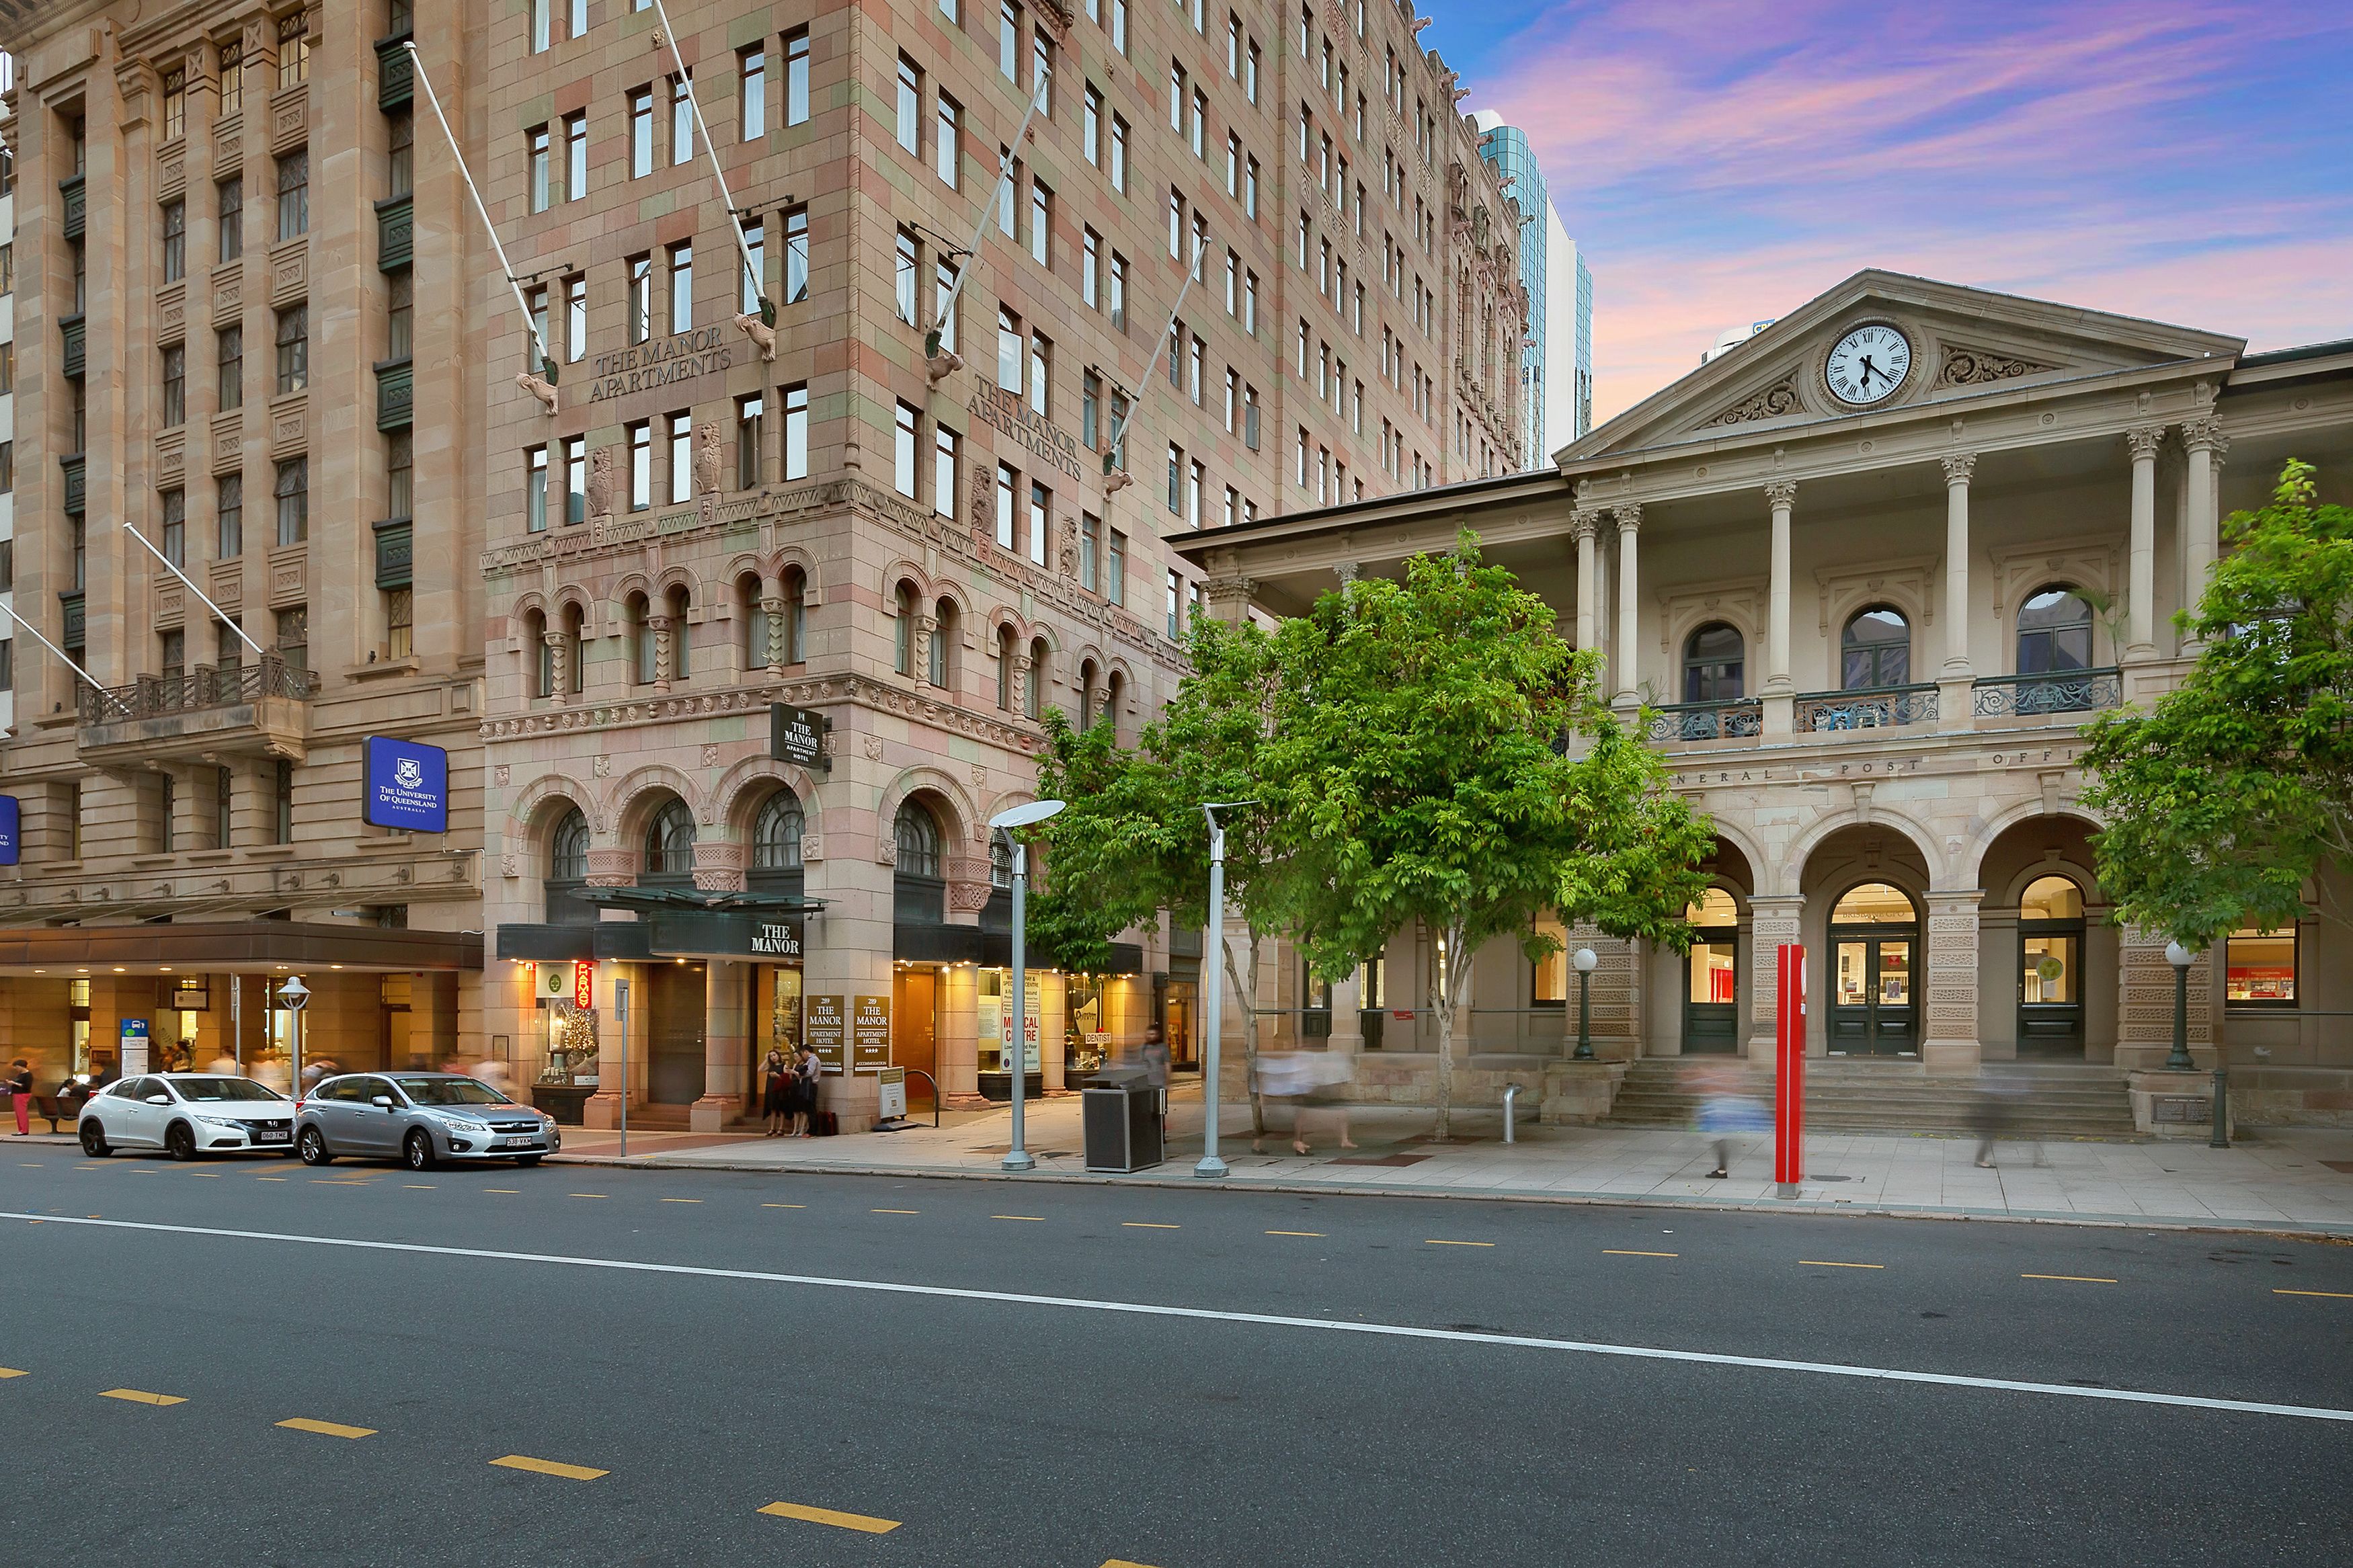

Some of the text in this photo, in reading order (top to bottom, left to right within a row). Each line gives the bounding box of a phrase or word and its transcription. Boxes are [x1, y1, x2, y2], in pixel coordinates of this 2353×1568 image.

[596, 327, 723, 378] THE MANOR
[589, 348, 731, 404] APARTMENTS
[975, 373, 1078, 459] THE MANOR
[966, 395, 1081, 482] APARTMENTS
[791, 721, 811, 736] THE
[785, 730, 818, 748] MANOR
[786, 745, 816, 757] APARTMENT
[793, 753, 809, 762] HOTEL
[1676, 749, 2073, 785] NERAL POST OFFI
[379, 786, 437, 801] THE UNIVERSITY
[379, 794, 438, 809] OF QUEENSLAND
[392, 805, 426, 813] AUSTRALIA
[762, 924, 790, 939] THE
[751, 937, 800, 954] MANOR
[578, 963, 590, 1008] PHARMACY
[816, 1005, 834, 1015] THE
[863, 1006, 881, 1016] THE
[809, 1016, 842, 1026] MANOR
[856, 1016, 887, 1026] MANOR
[1004, 1016, 1039, 1028] MCAL
[1006, 1030, 1037, 1042] CRE
[1086, 1034, 1111, 1042] DENTIST
